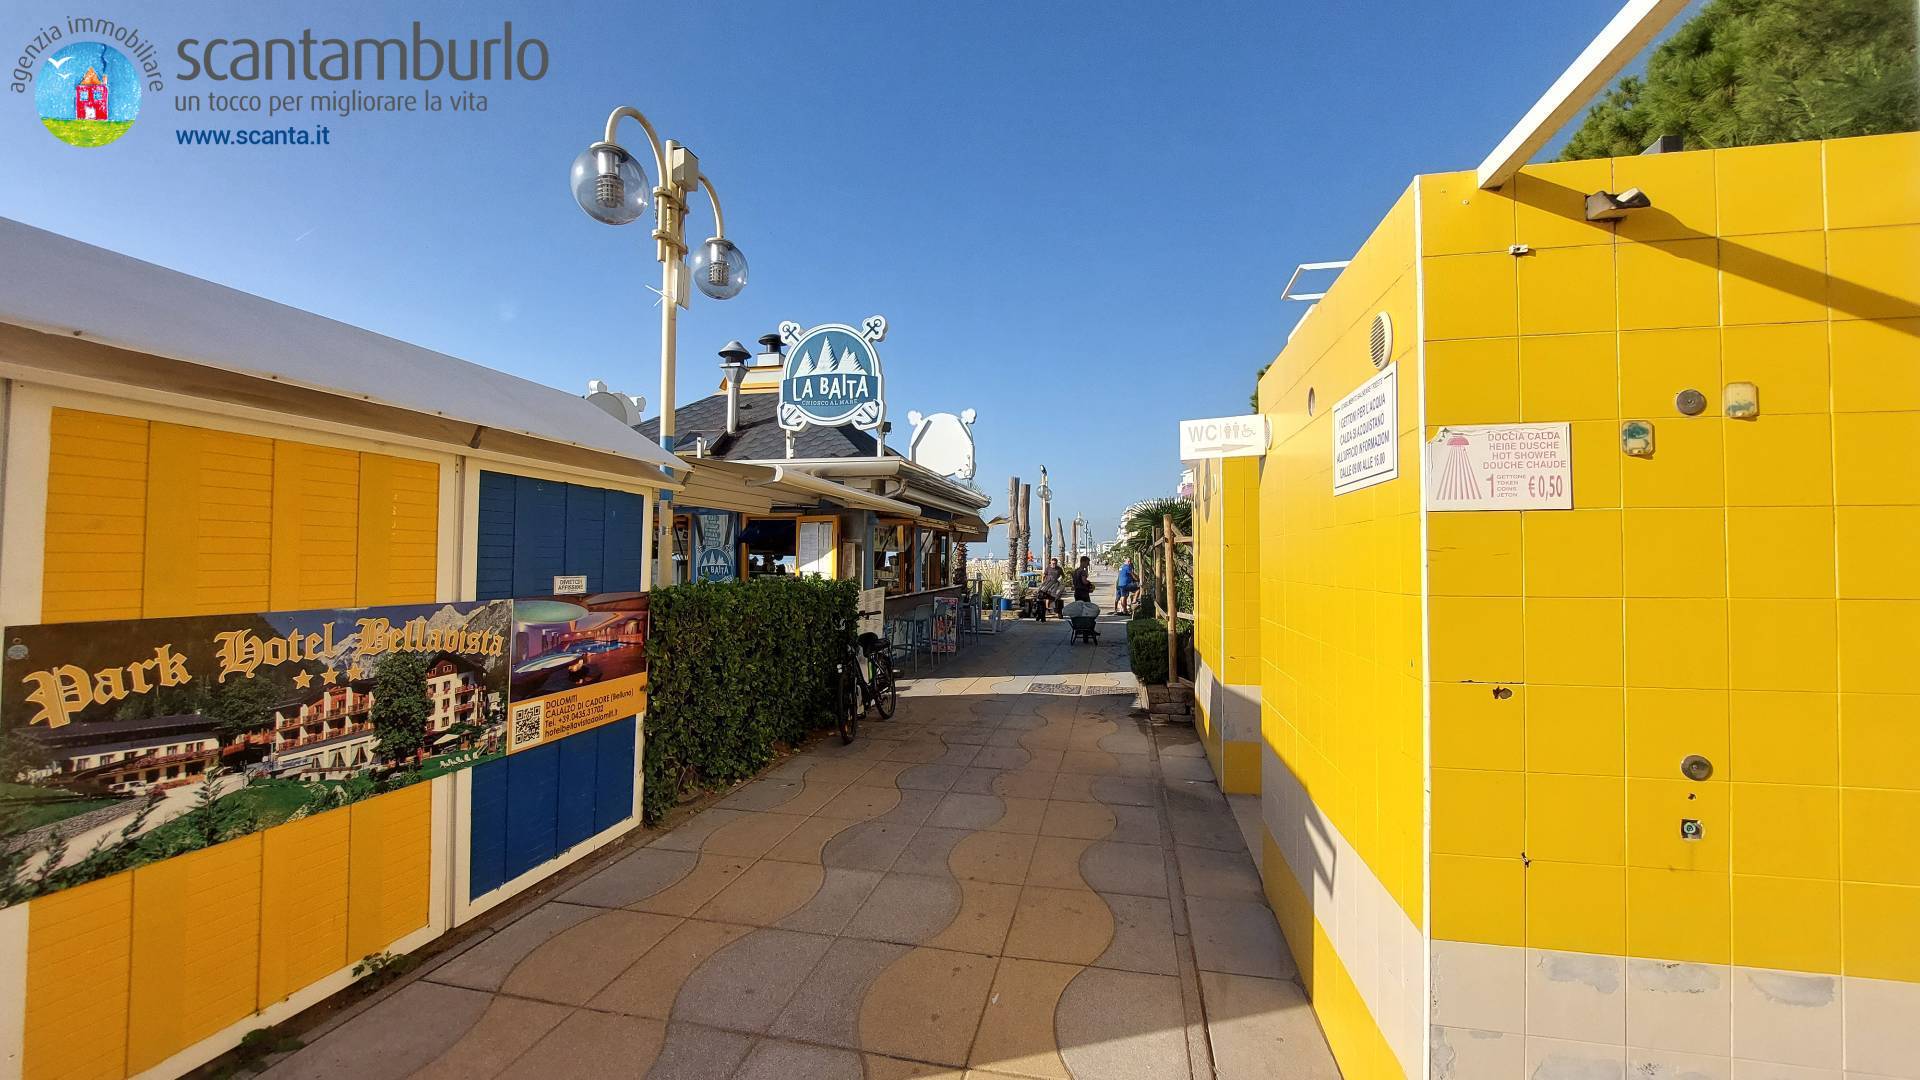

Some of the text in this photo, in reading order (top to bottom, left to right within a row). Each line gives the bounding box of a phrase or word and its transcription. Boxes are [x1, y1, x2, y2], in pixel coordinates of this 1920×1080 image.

[793, 374, 869, 401] LA BAITA
[1357, 404, 1365, 419] PER
[1187, 424, 1217, 442] WC
[1340, 431, 1353, 446] CALDA
[1357, 412, 1384, 438] ACQUISTANO
[1487, 431, 1560, 441] DOCCIA CALDA
[1359, 429, 1389, 454] INFORMAZIONI
[1520, 441, 1560, 450] DUSCHE
[1492, 450, 1557, 460] HOT SHOWER
[1363, 456, 1373, 470] ALLE
[1482, 460, 1567, 470] DOUCHE CHAUDE
[1486, 473, 1494, 498] 1
[710, 564, 729, 575] BAITA
[22, 616, 506, 729] Park Hotel Bellavista
[545, 694, 578, 710] DOLOMITI
[545, 704, 576, 719] CALALZO
[577, 702, 584, 710] DI
[585, 694, 610, 708] CADORE
[545, 718, 556, 728] Tel.
